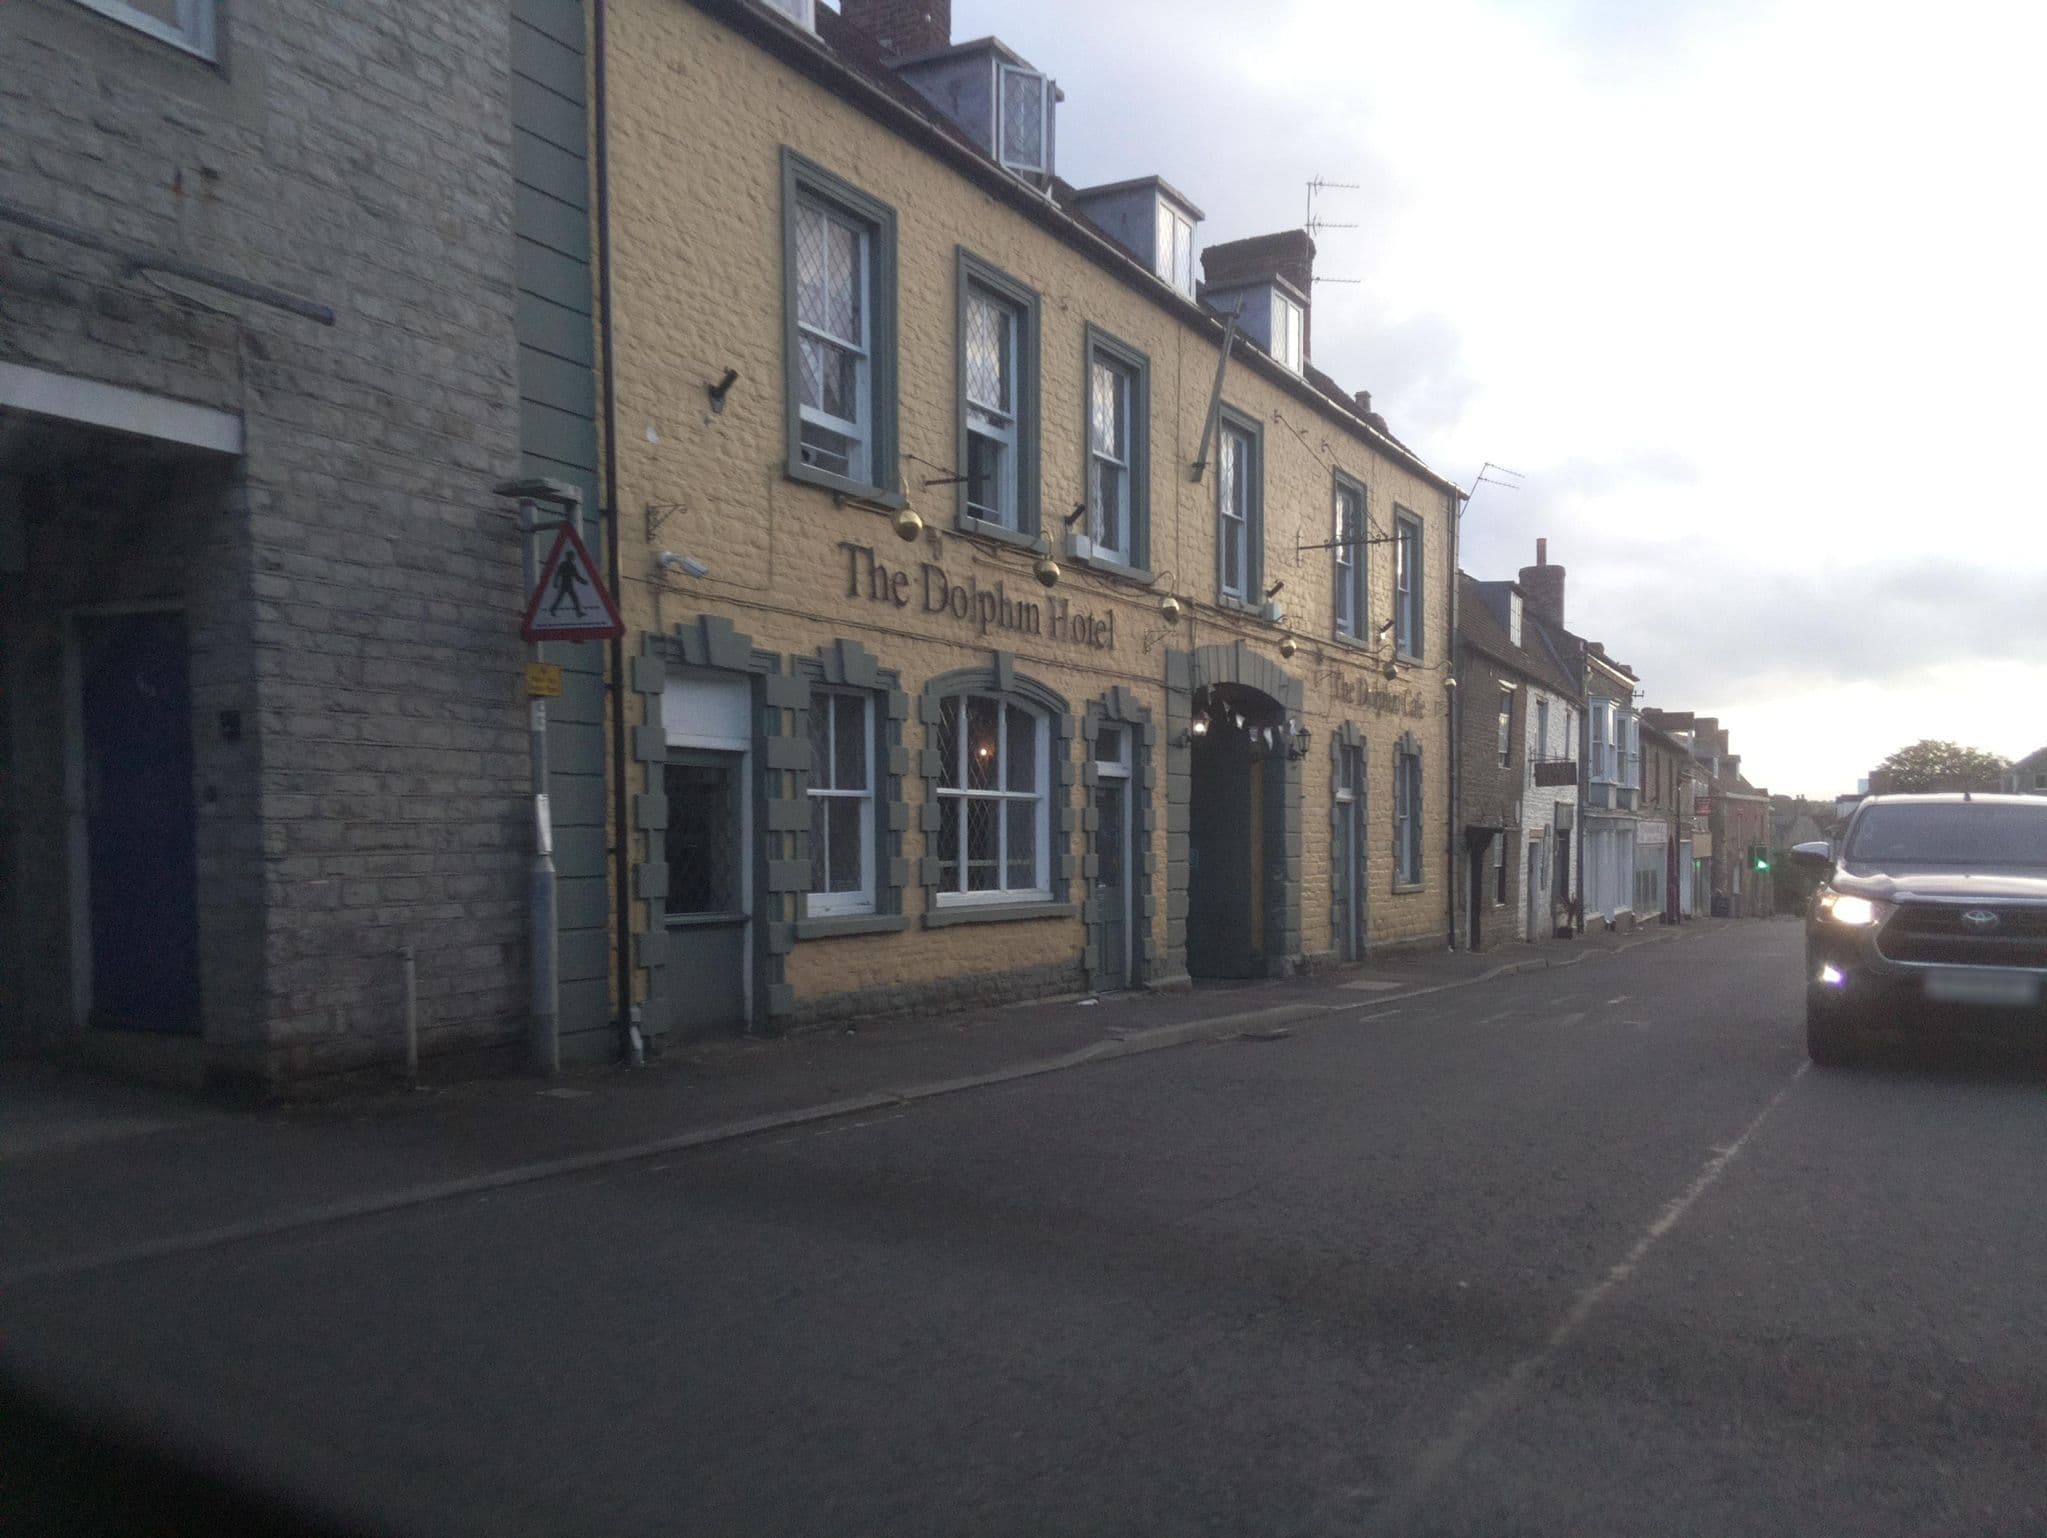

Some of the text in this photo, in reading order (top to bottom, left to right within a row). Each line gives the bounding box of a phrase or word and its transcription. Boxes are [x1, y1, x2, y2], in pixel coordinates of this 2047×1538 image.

[838, 541, 1115, 650] The Dolphin Hotel
